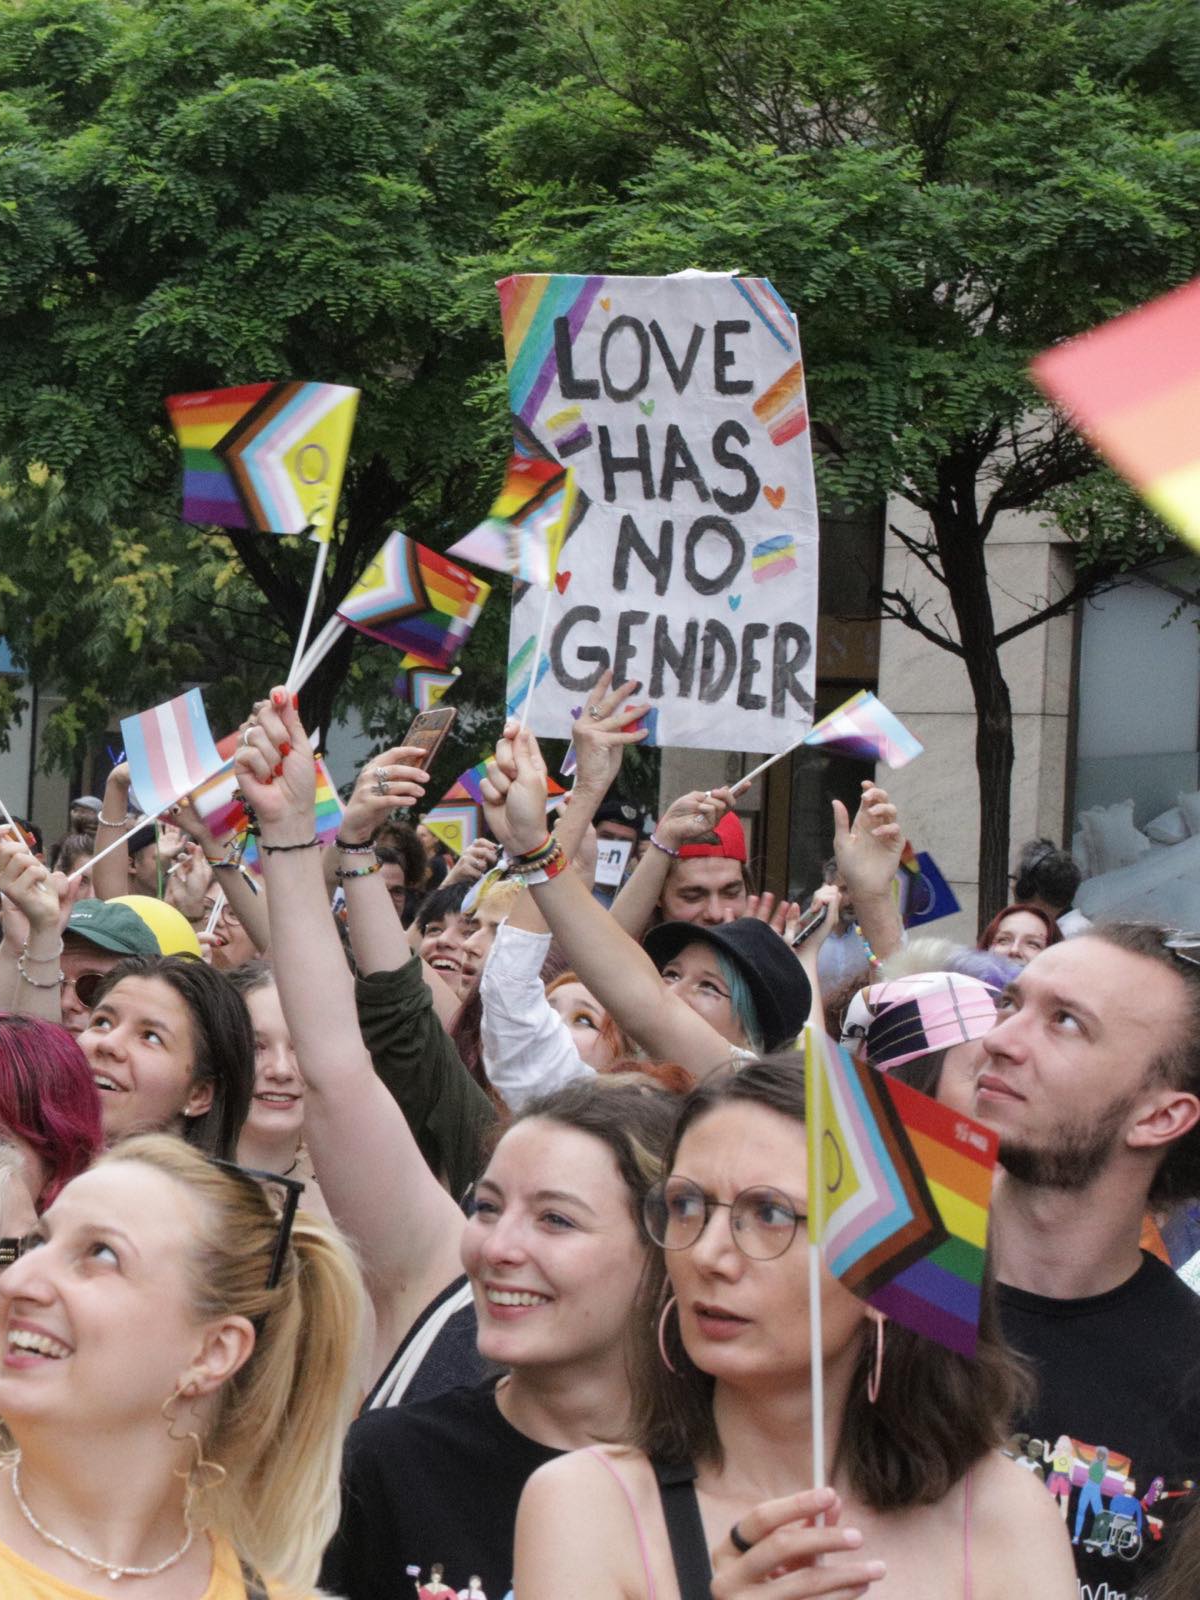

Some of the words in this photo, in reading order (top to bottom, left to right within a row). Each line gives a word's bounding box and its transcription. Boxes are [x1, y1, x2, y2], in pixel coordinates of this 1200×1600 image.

[553, 314, 754, 401] LOVE
[598, 419, 761, 514] HAS
[612, 514, 746, 597] NO
[549, 604, 816, 718] GENDER
